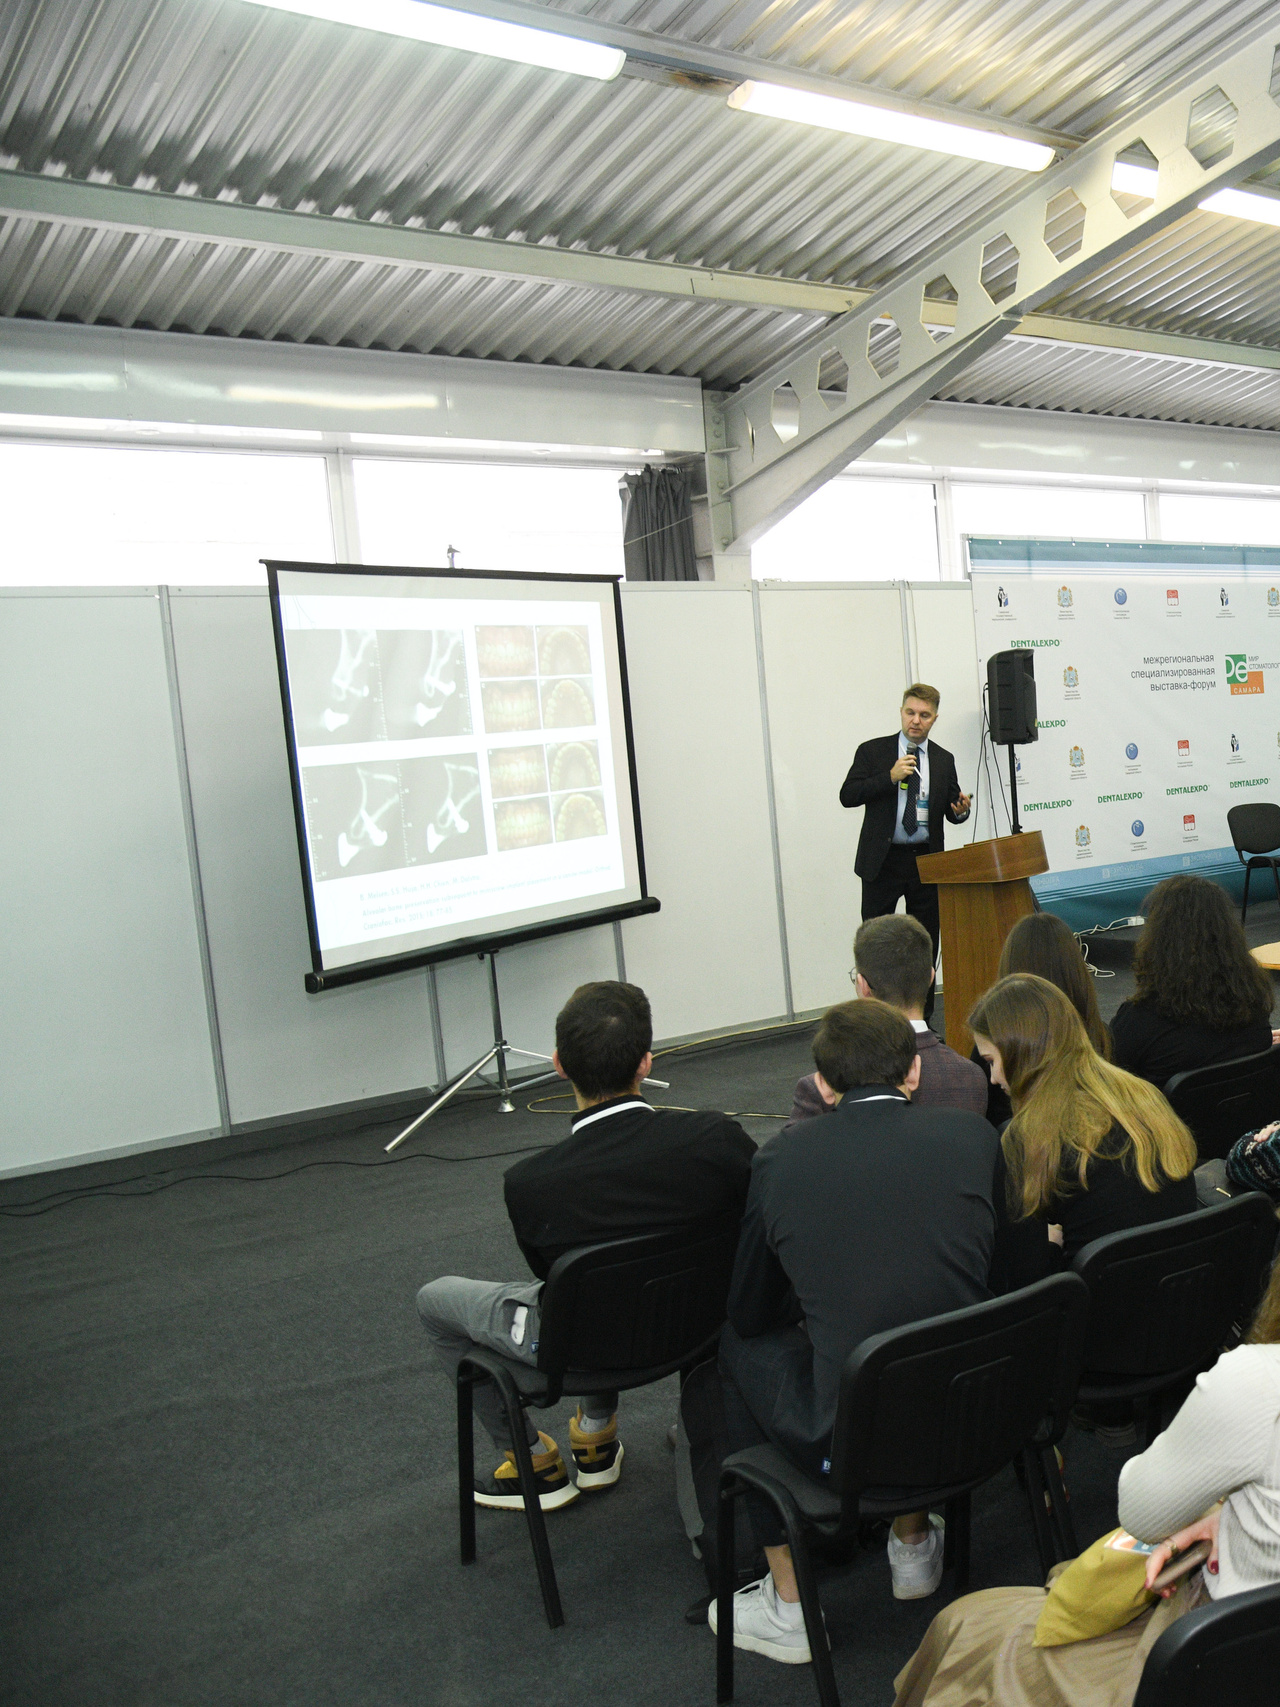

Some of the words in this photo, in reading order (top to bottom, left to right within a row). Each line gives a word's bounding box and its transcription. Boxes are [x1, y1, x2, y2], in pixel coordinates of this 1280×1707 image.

[1010, 639, 1061, 648] DENTALEXPO
[1143, 654, 1215, 666] межрегиональная
[1130, 667, 1216, 679] специализированная
[1150, 680, 1217, 692] выставка-форум
[1233, 686, 1261, 694] САМАРА
[1036, 719, 1066, 728] ALEXPO
[1229, 777, 1269, 788] DENTALEXPO
[1166, 785, 1209, 796] DENTALEXPO
[1097, 792, 1143, 803] DENTALEXPO
[1023, 800, 1072, 812] DENTALEXPO
